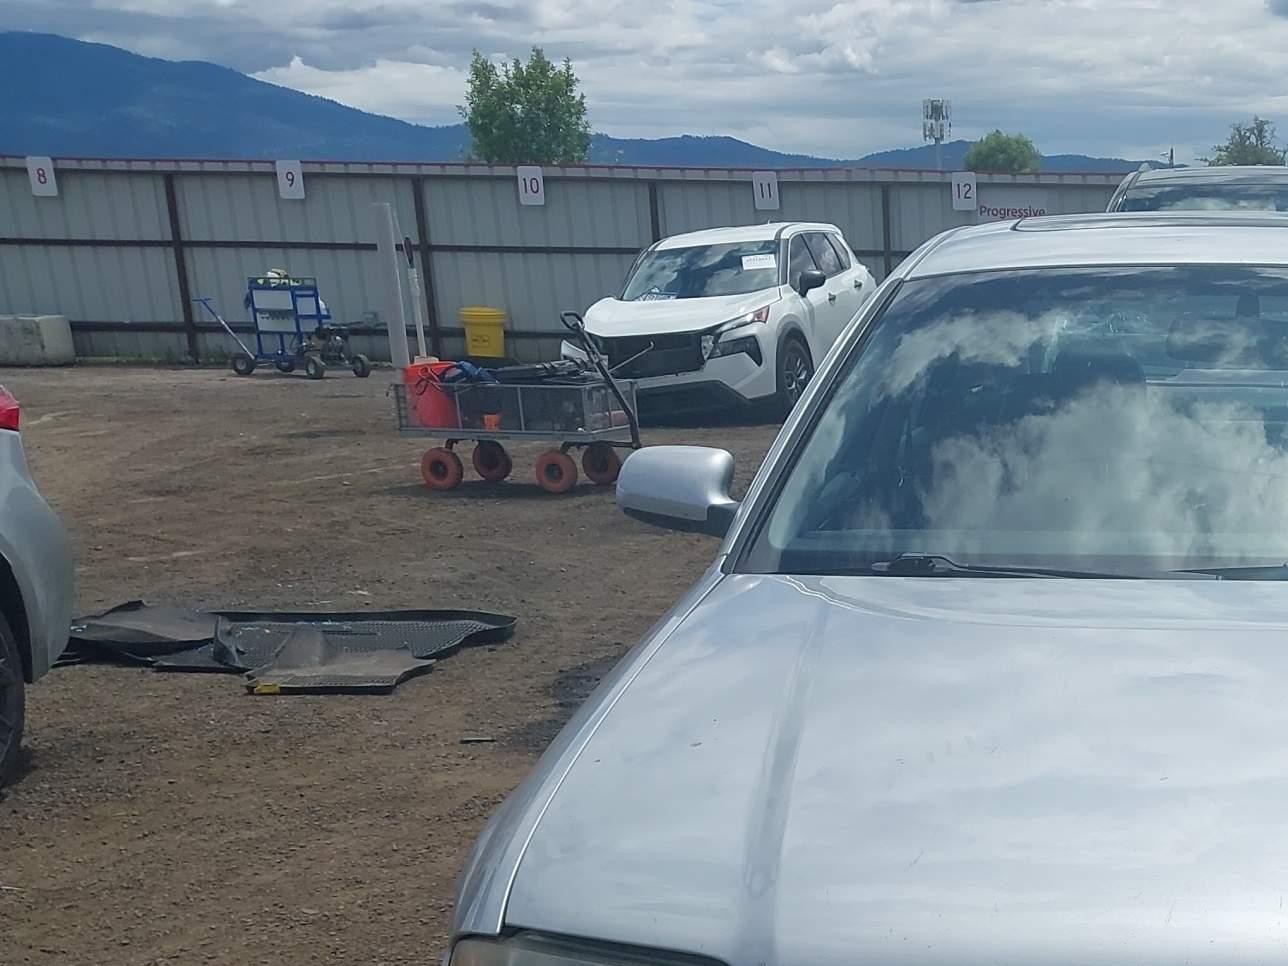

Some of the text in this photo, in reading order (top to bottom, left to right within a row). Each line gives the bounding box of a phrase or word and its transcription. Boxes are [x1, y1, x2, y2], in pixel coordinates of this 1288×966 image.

[36, 167, 47, 185] 8
[285, 171, 295, 187] 9
[522, 177, 540, 194] 10
[760, 182, 771, 199] 11
[957, 183, 973, 199] 12
[979, 205, 1046, 219] Progressive
